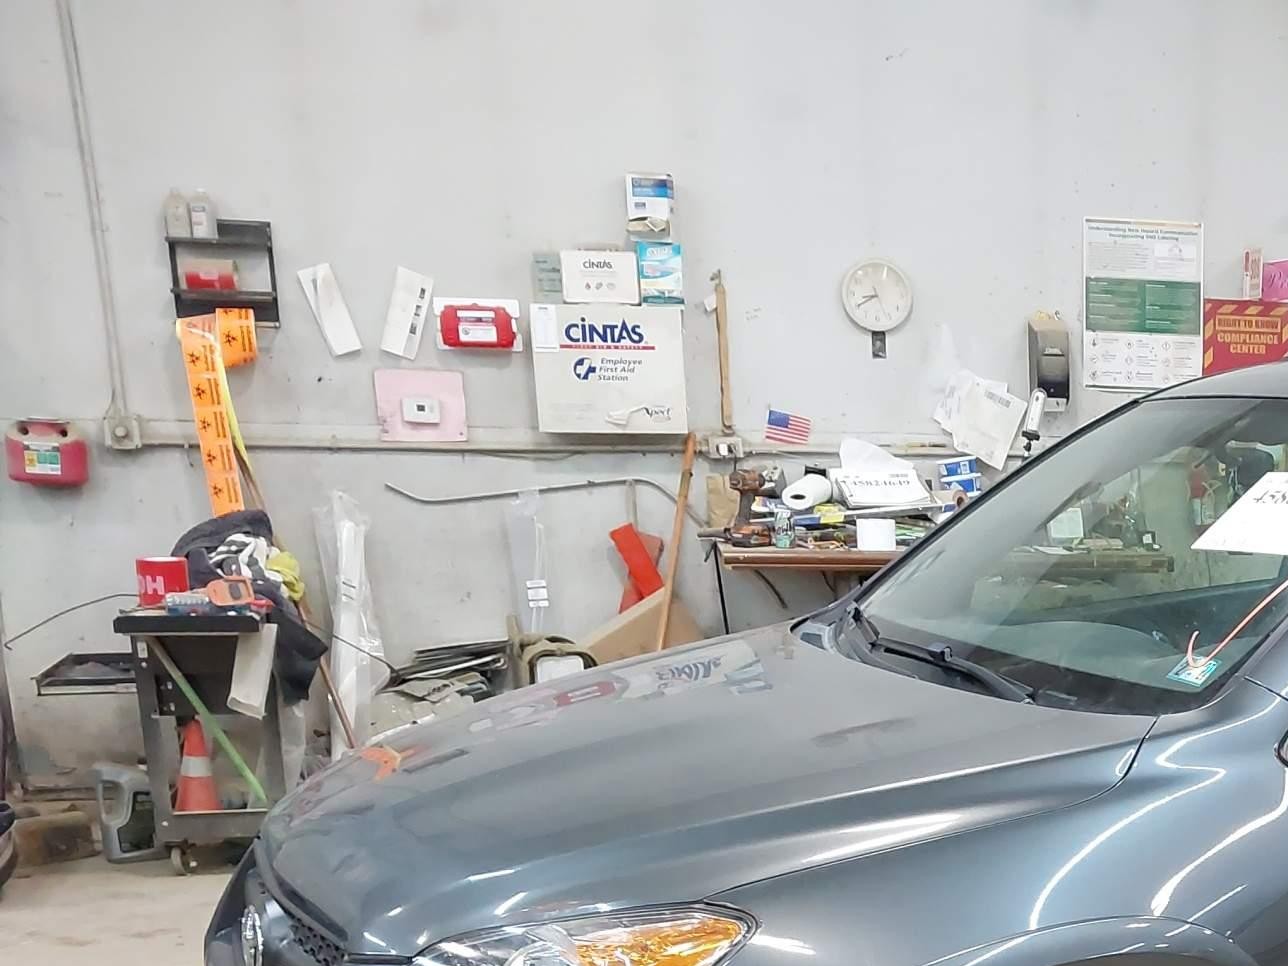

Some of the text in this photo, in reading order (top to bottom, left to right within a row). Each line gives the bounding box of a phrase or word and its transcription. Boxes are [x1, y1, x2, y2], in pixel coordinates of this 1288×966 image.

[1217, 332, 1279, 345] COMPLIANCE
[1229, 344, 1266, 354] CENTER
[600, 358, 643, 368] Employee
[598, 366, 636, 374] First Aid
[597, 374, 629, 382] Station
